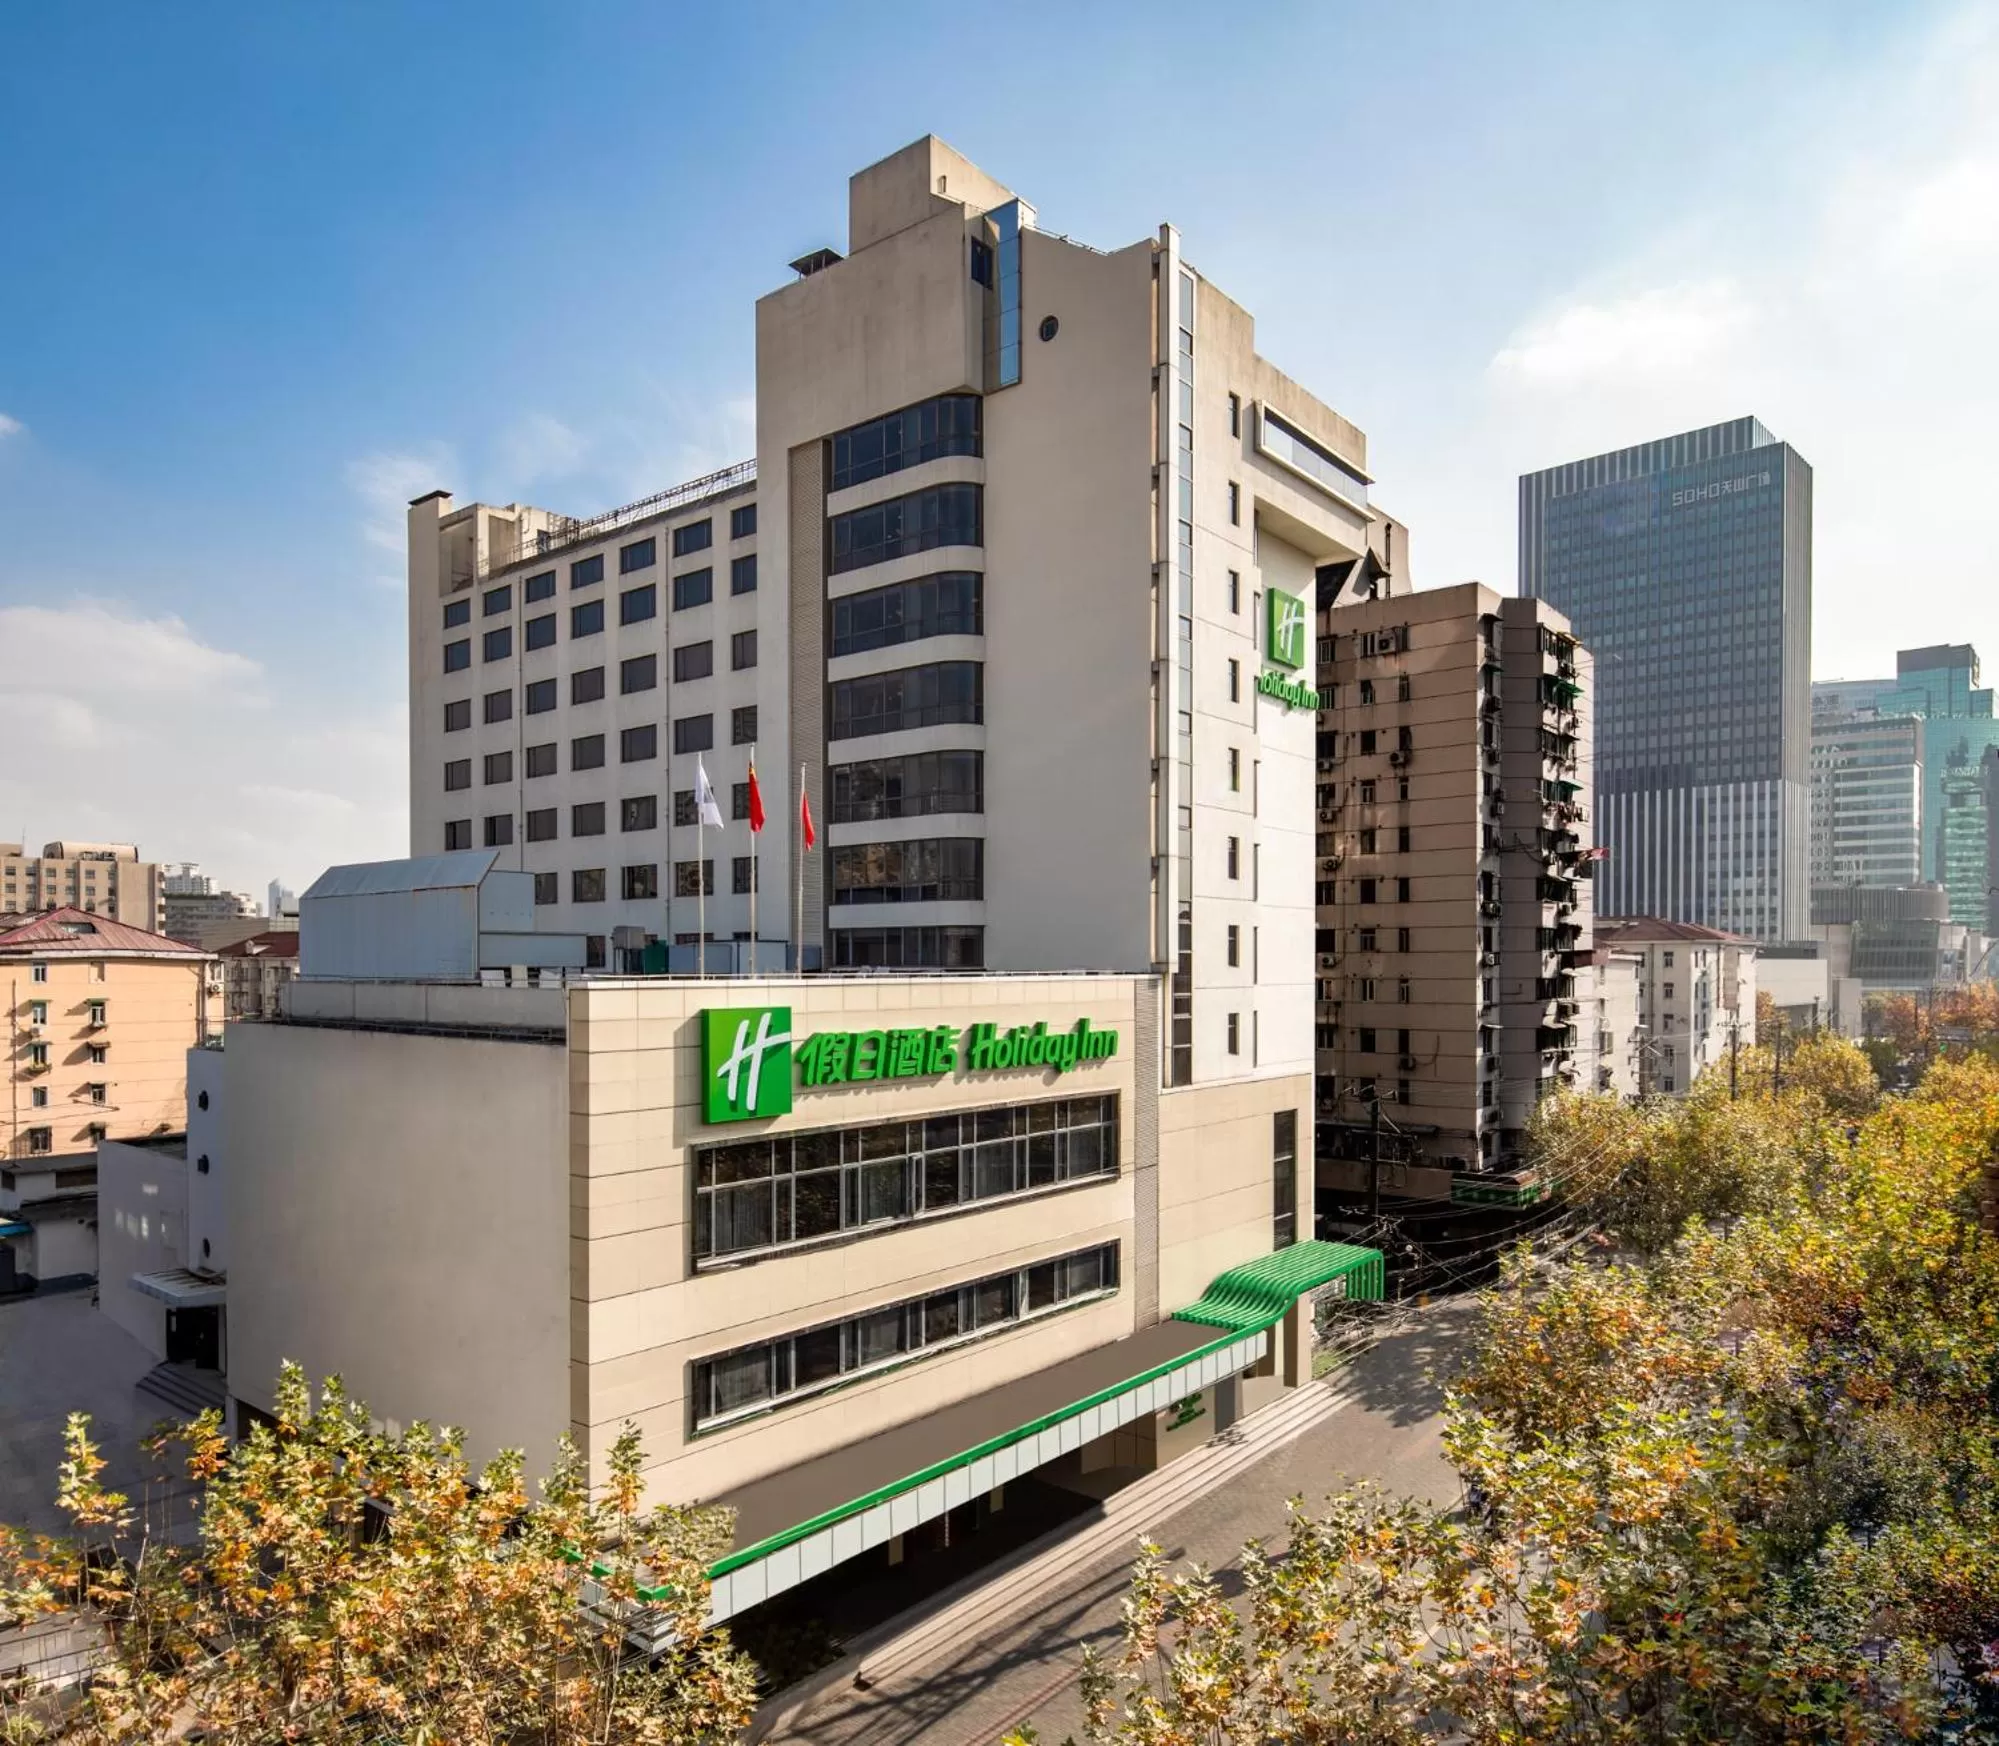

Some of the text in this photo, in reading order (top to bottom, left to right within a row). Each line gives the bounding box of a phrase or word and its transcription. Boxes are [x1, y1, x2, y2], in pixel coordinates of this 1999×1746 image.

[797, 1018, 1119, 1085] 假日酒店 Holiday Inn
